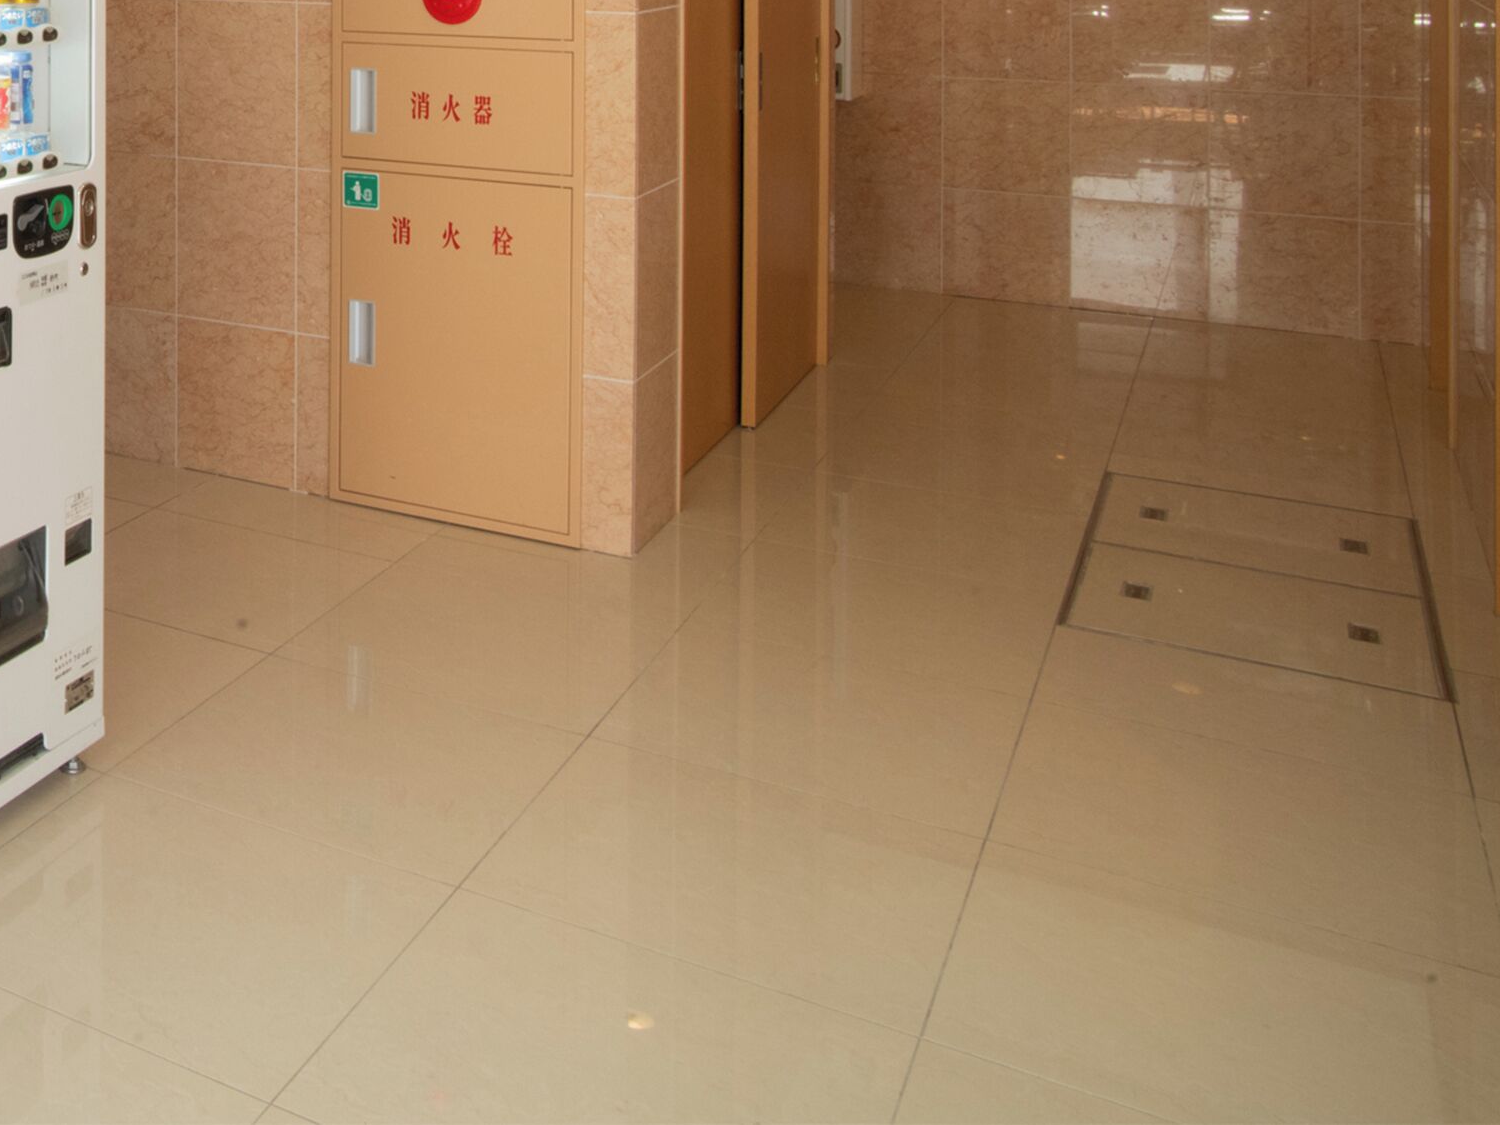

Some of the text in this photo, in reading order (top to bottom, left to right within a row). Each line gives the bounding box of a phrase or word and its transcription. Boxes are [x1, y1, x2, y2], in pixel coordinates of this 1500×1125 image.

[410, 91, 493, 125] 消火器
[391, 216, 514, 257] 消火栓
